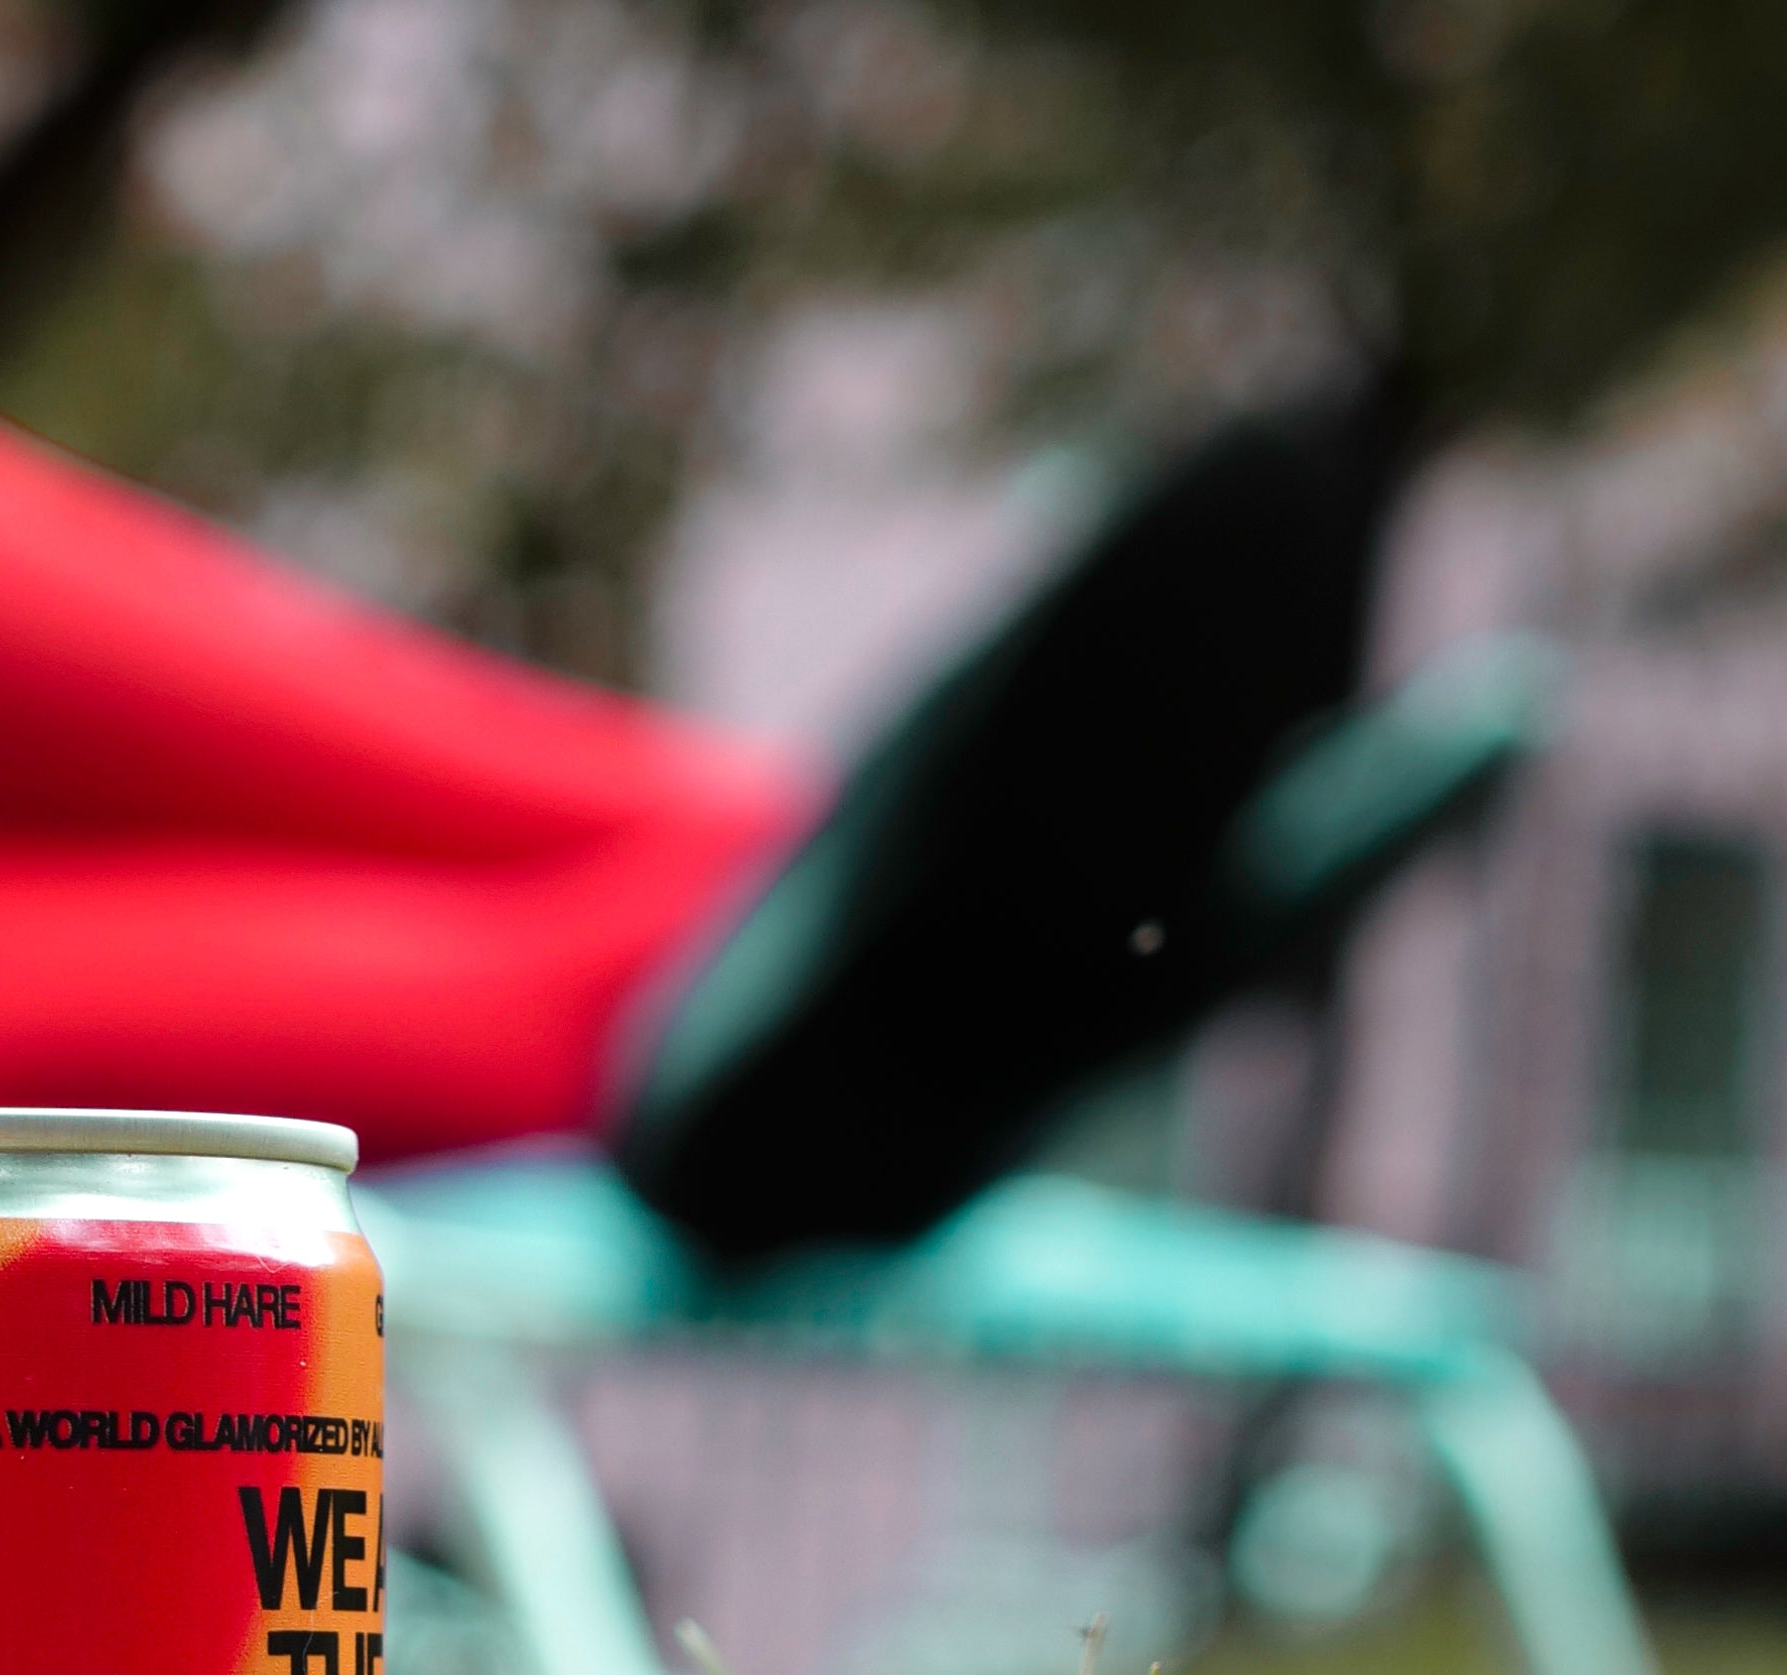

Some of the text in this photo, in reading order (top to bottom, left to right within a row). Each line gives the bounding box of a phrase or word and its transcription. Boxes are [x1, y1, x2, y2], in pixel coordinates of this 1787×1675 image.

[91, 1280, 301, 1329] MILD HARE
[5, 1411, 159, 1449] WORLD
[164, 1413, 349, 1455] GLAMORIZED
[351, 1419, 370, 1457] BY
[238, 1486, 367, 1612] WE
